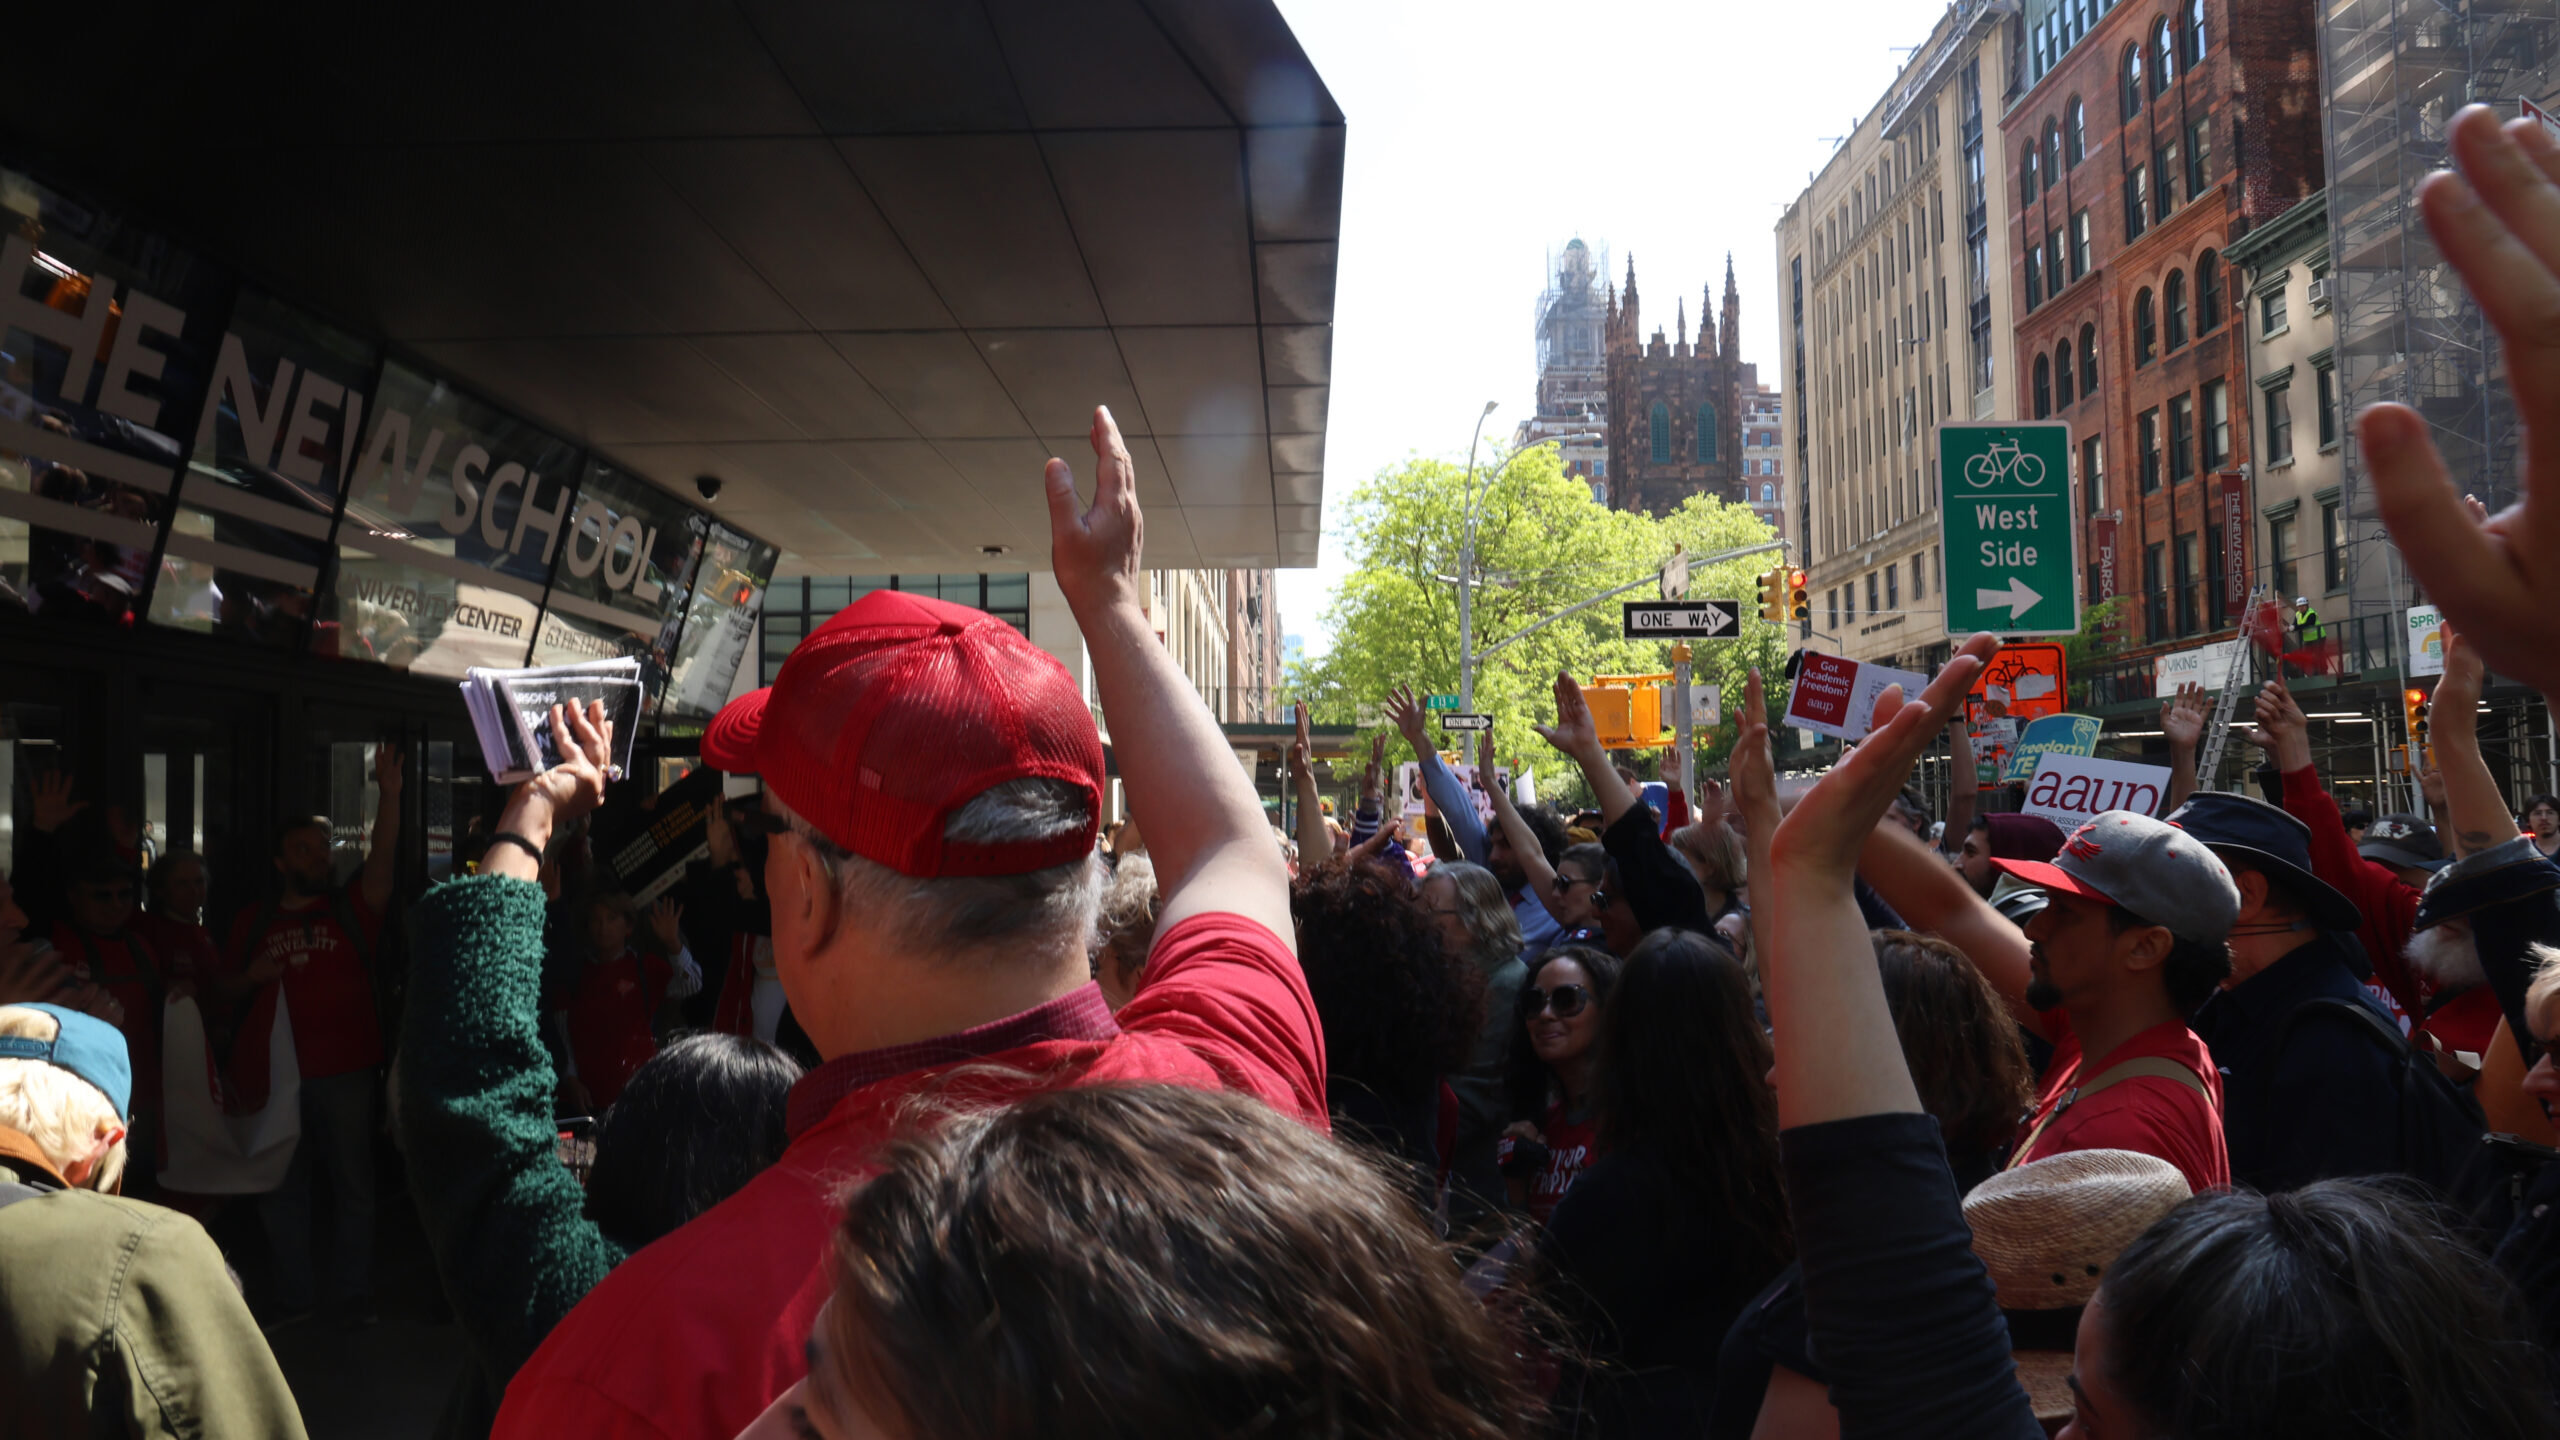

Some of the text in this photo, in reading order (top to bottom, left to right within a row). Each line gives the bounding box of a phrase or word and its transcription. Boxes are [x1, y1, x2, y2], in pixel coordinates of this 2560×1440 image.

[189, 331, 446, 516] NEW
[440, 443, 661, 604] SCHOOL
[1975, 504, 2039, 530] West
[1980, 541, 2038, 567] Side
[2231, 491, 2244, 602] THE NEW SCHOOL
[456, 604, 522, 638] CENTER
[1640, 612, 1721, 627] ONE WAY
[1820, 661, 1839, 673] Got
[2168, 655, 2198, 672] VIKING
[1803, 668, 1850, 687] Academic
[1801, 678, 1849, 697] Freedom?
[1430, 696, 1436, 708] E
[1439, 696, 1447, 708] 13
[1807, 698, 1834, 715] aaup
[1449, 718, 1485, 726] ONE WAY
